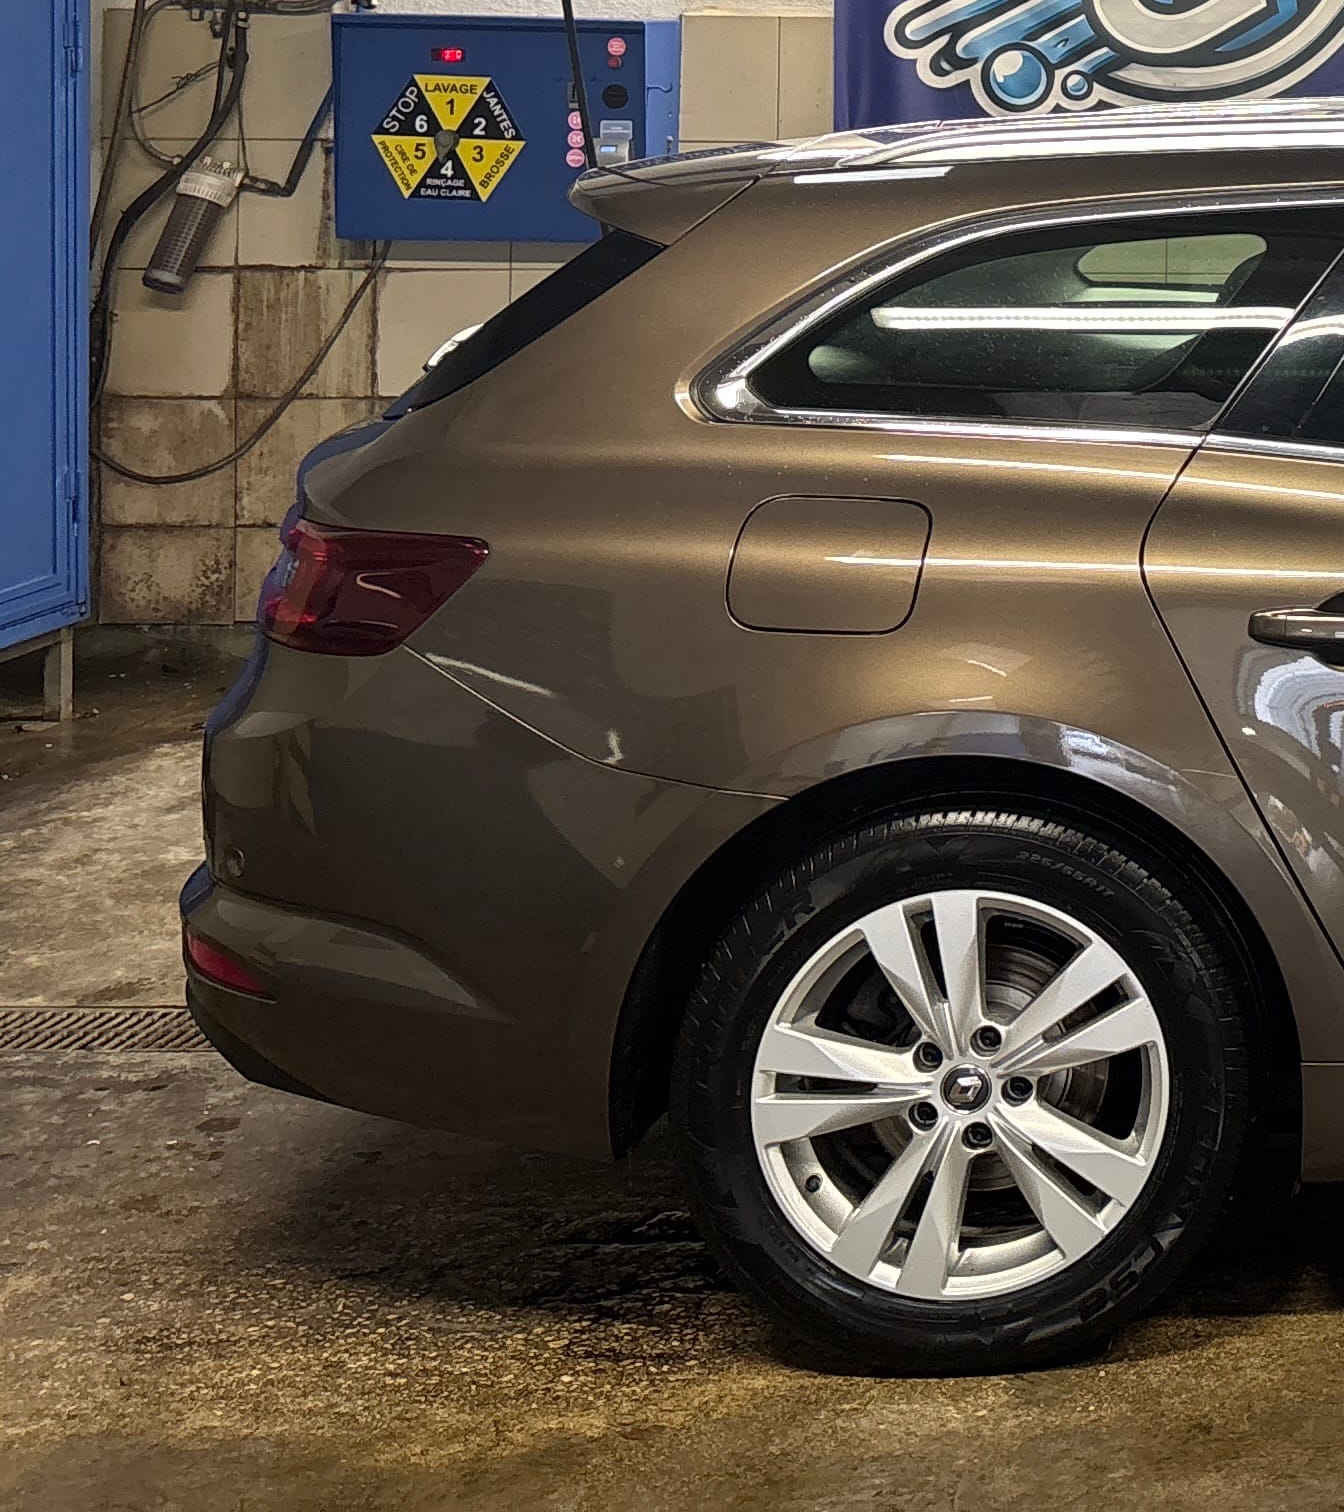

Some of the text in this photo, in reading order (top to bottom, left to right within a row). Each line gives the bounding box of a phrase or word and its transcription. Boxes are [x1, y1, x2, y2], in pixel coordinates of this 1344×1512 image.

[424, 83, 478, 95] LAVAGE
[383, 86, 421, 133] STOP
[445, 98, 455, 115] 1
[483, 90, 516, 139] JANTES
[414, 115, 428, 133] 6
[473, 117, 487, 135] 2
[413, 142, 426, 160] 5
[472, 145, 485, 162] 3
[378, 140, 413, 192] PROTECTION
[440, 159, 454, 177] 4
[478, 144, 515, 189] BROSSE
[426, 178, 465, 188] RINÇAGE
[420, 188, 472, 198] EAU CLAIRE
